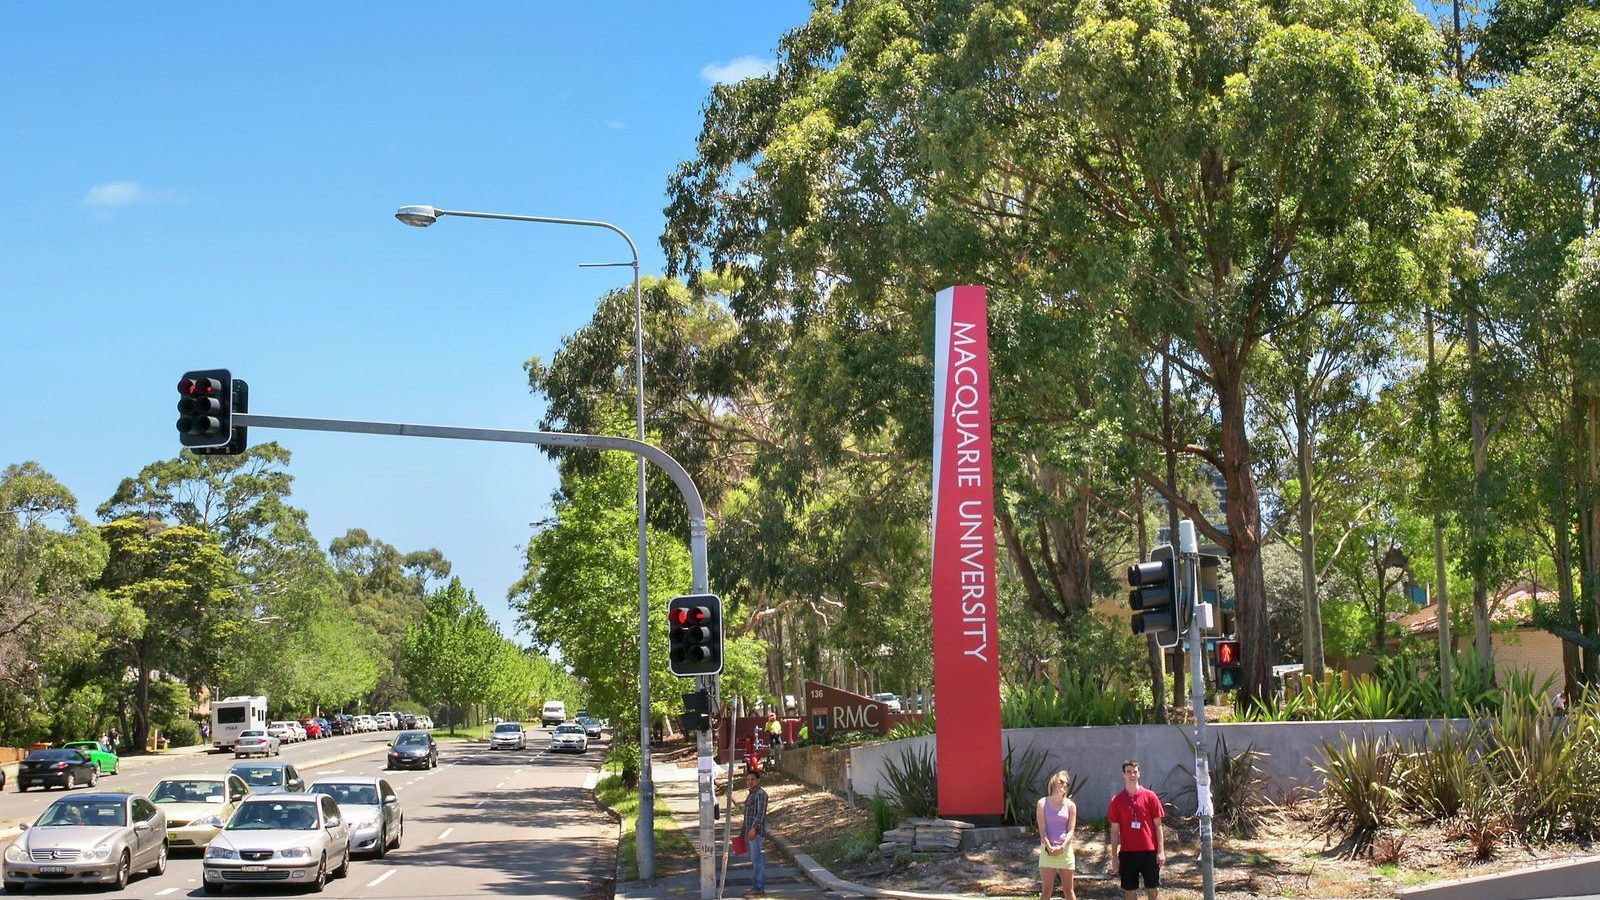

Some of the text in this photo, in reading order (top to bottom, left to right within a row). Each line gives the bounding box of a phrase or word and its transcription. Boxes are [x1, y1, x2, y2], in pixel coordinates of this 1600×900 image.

[951, 322, 988, 662] MACQUARIE UNIVERSITY
[810, 689, 824, 698] 136
[833, 704, 879, 729] RMC
